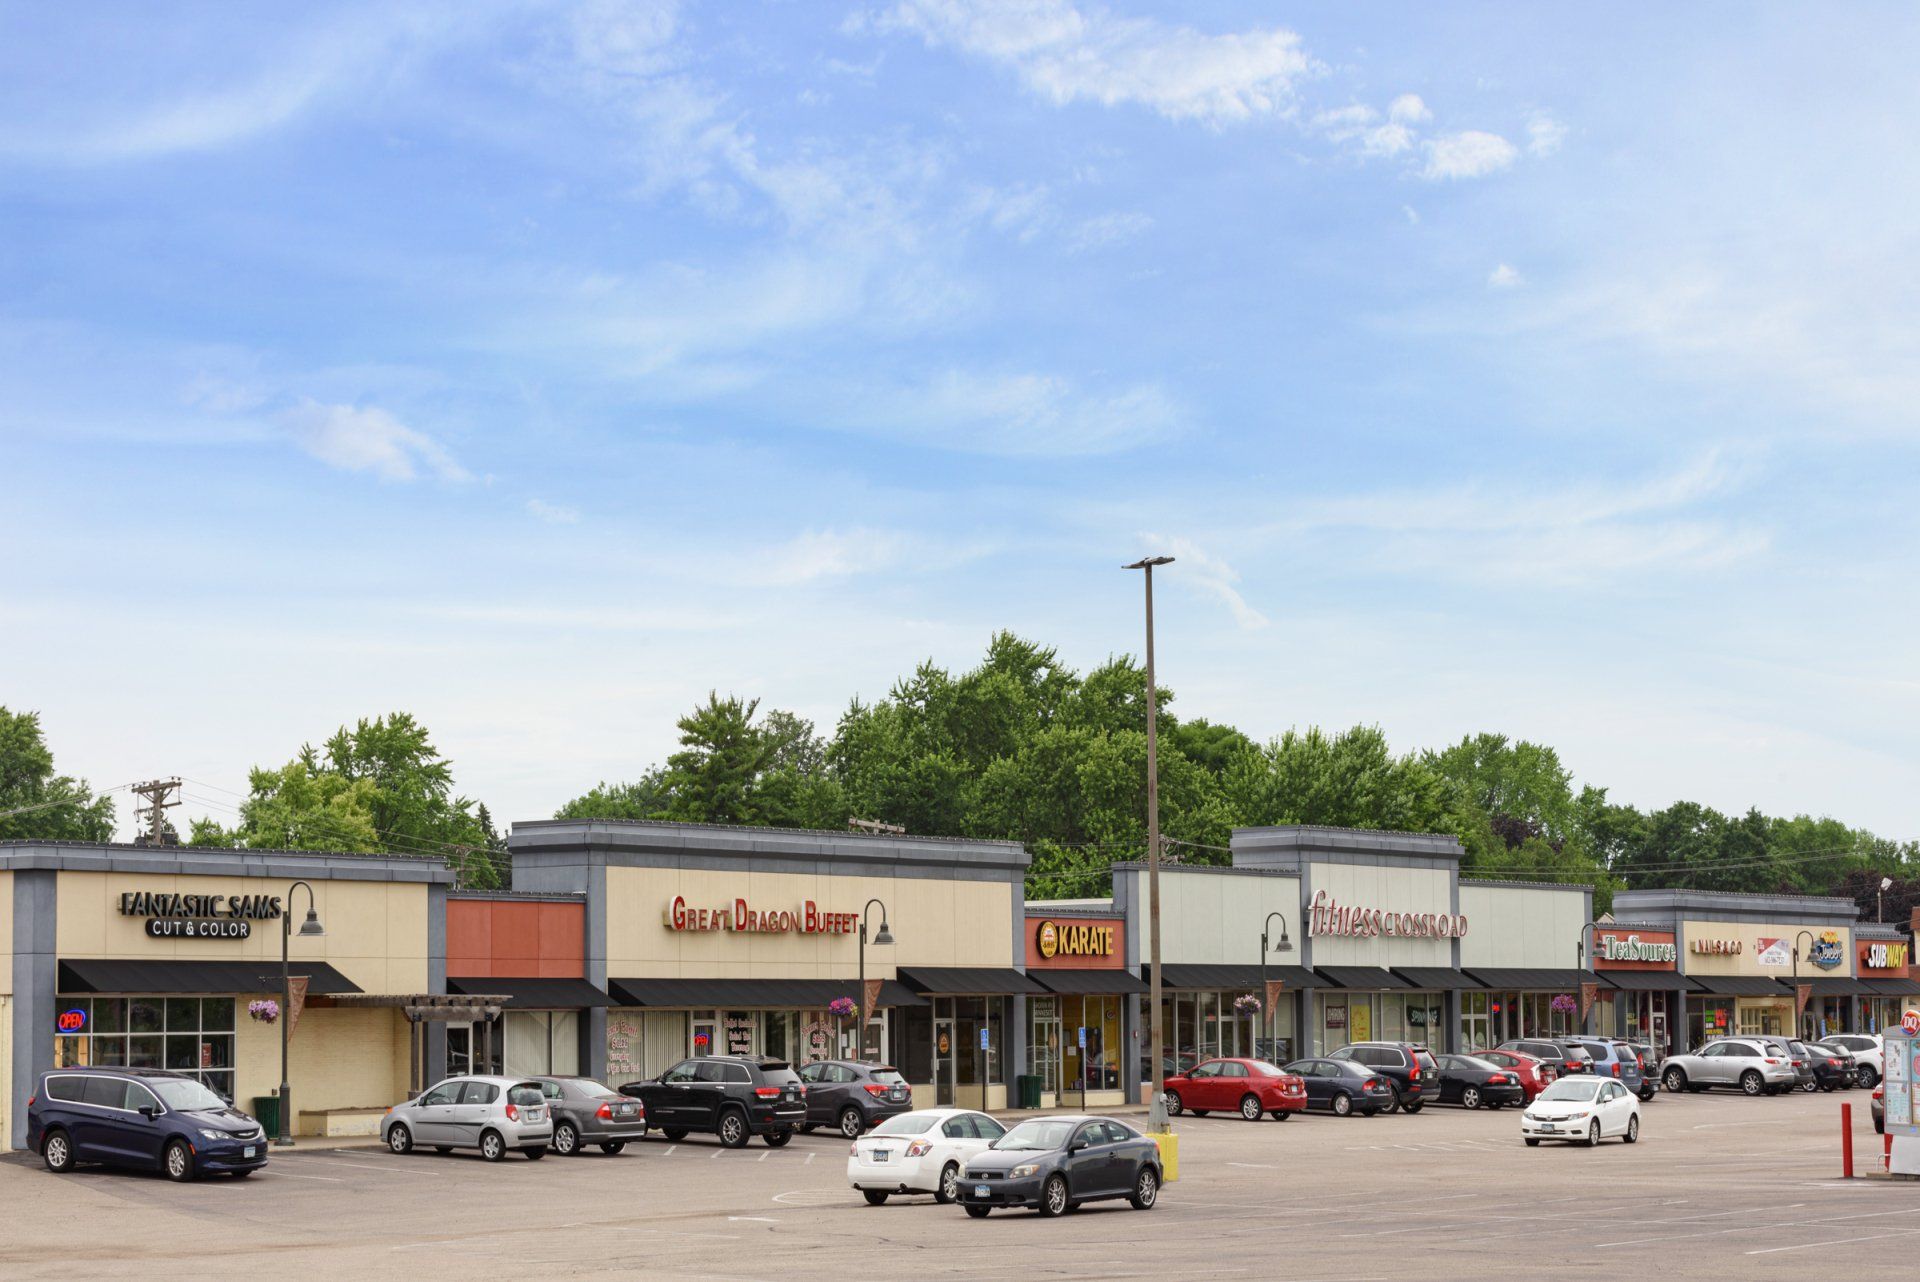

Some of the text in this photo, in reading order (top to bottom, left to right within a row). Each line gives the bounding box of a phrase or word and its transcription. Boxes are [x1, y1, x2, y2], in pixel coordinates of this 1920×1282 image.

[122, 892, 282, 919] FANTASTIC SAMS
[670, 895, 859, 934] GREAT DRAGON BUFFET
[1309, 890, 1468, 940] fitness CROSSROAD
[152, 920, 248, 936] CUT & COLOR
[1059, 926, 1114, 955] KARATE
[1605, 936, 1676, 961] TeaSource
[1868, 943, 1908, 968] SUBWAY
[59, 1013, 83, 1029] OPEN
[1904, 1016, 1917, 1030] DQ
